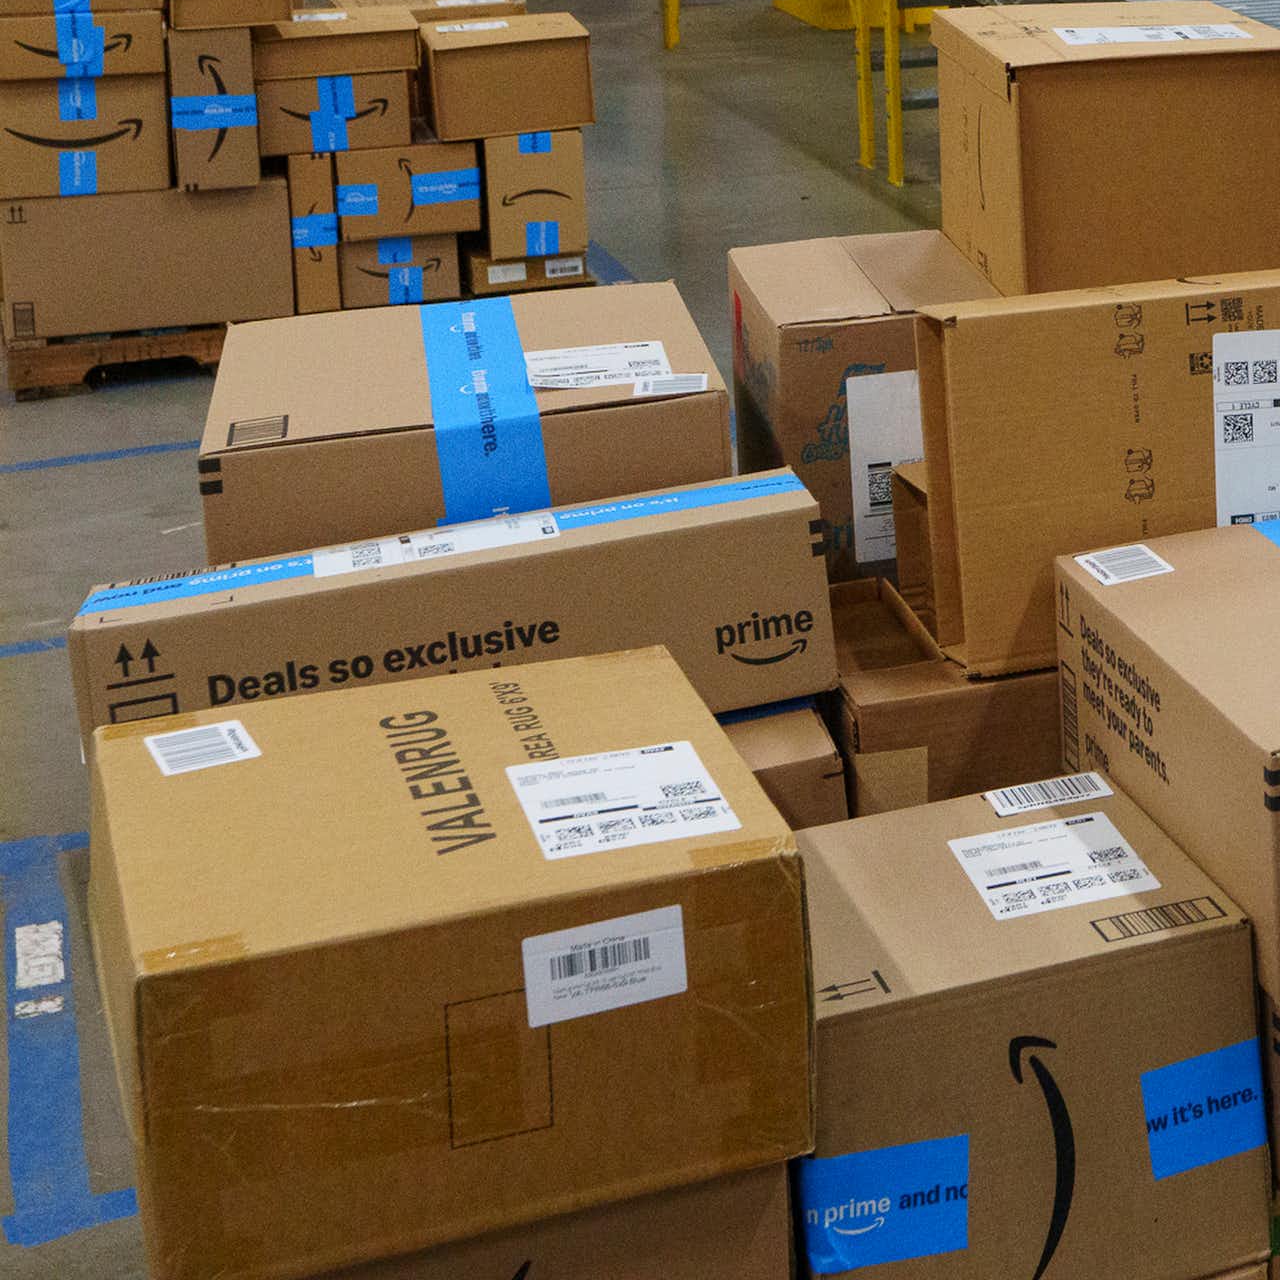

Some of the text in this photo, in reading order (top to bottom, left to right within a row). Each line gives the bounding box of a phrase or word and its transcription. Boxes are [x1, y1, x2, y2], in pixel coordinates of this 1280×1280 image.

[1240, 401, 1260, 410] CYCLE
[621, 501, 645, 511] on
[714, 609, 815, 655] prime
[208, 619, 561, 707] Deals so exclusive
[1080, 614, 1161, 713] Deals so exclusive
[1081, 648, 1154, 738] they're ready to
[503, 702, 542, 733] RUG
[1082, 680, 1171, 785] meet your parents.
[1084, 732, 1110, 772] prime
[379, 710, 497, 857] VALENRUG
[1173, 1104, 1204, 1125] it's
[1207, 1084, 1258, 1115] here.
[824, 1194, 891, 1228] prime
[899, 1184, 942, 1210] and
